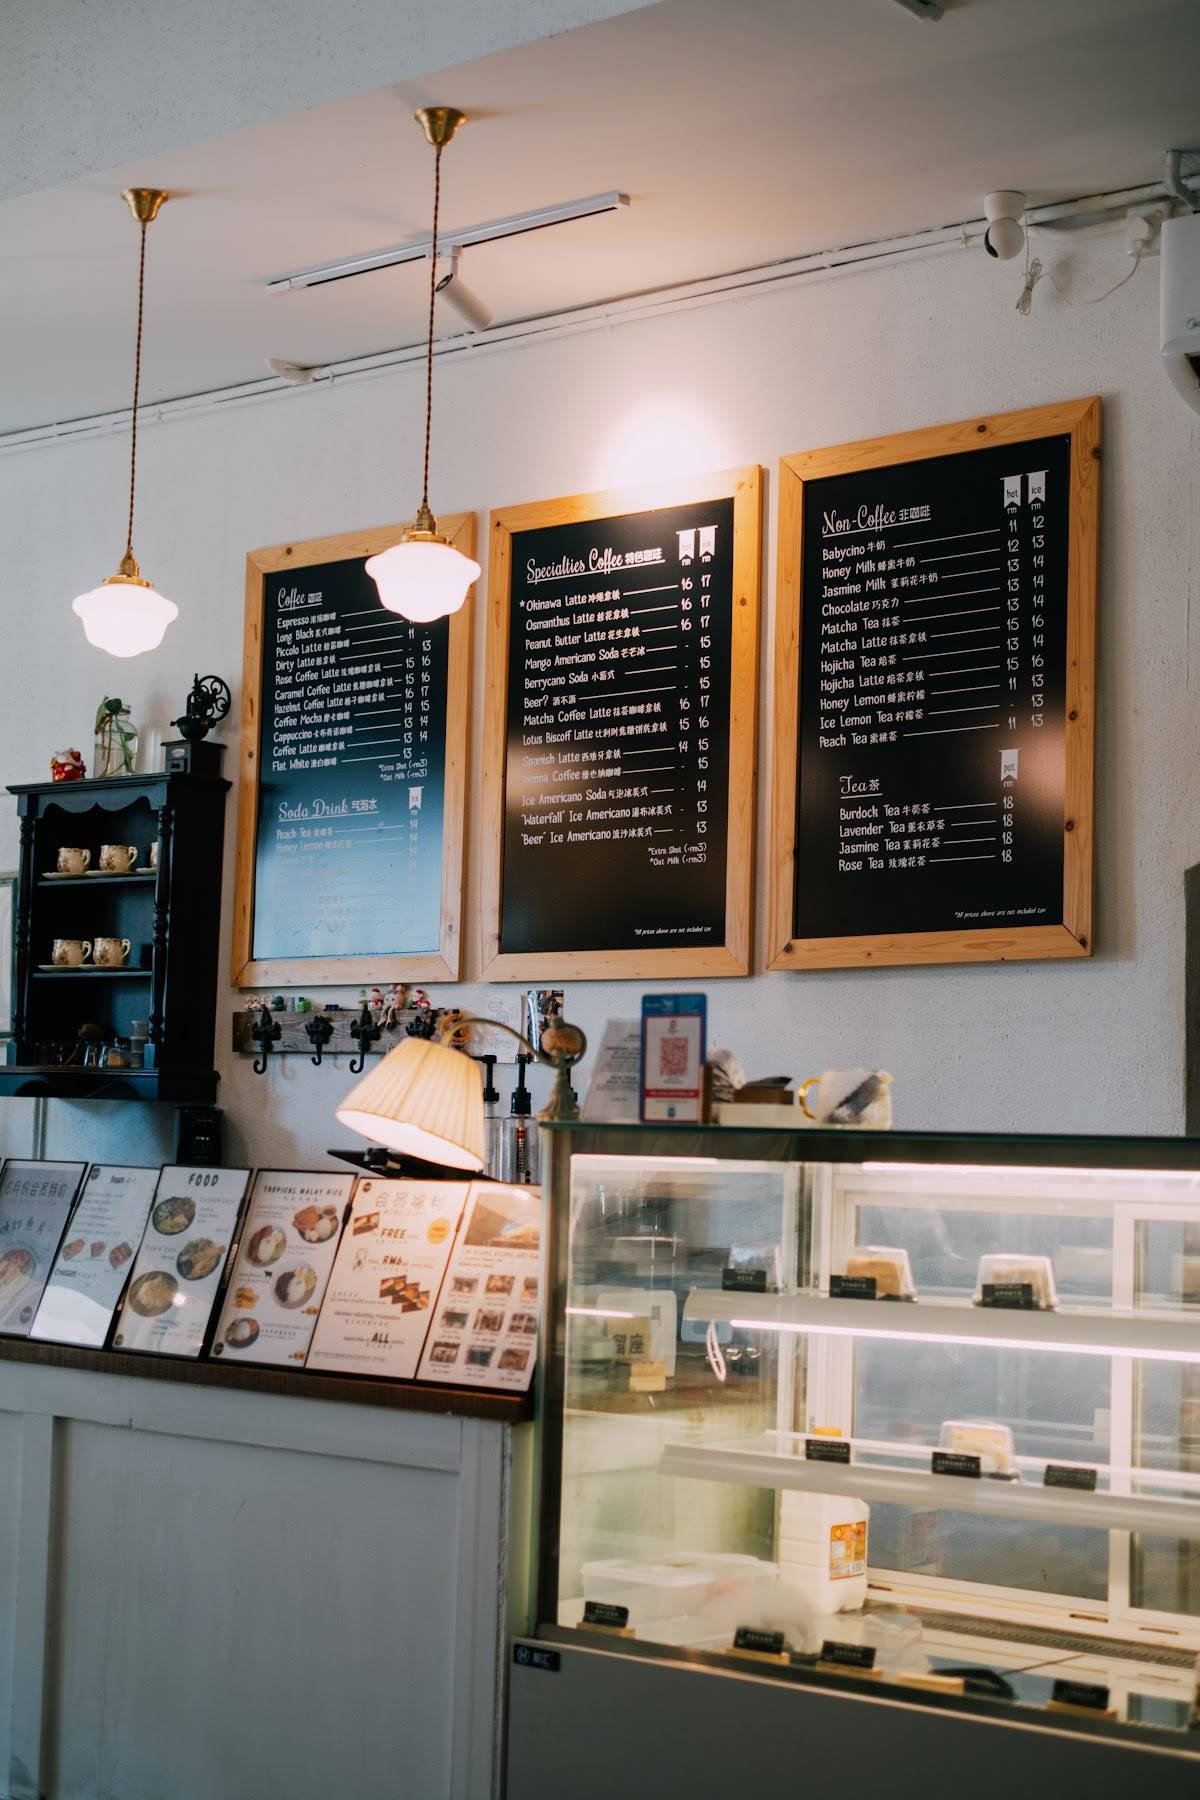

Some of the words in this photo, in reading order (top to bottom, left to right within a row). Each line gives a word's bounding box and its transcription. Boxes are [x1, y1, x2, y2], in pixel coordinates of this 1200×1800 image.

[1006, 488, 1019, 498] hot
[1031, 484, 1042, 495] ice
[1006, 506, 1017, 514] rm
[1030, 502, 1041, 511] rm
[822, 504, 897, 535] Non-Coffee
[822, 544, 865, 562] Babycino
[866, 540, 886, 552] 牛奶
[1009, 519, 1017, 532] 11
[1032, 515, 1044, 528] 12
[526, 555, 586, 585] Specialties
[588, 547, 624, 575] Coffee
[821, 582, 861, 598] Jasmine
[865, 577, 886, 592] Milk
[1007, 558, 1019, 572] 13
[1032, 554, 1044, 568] 14
[822, 566, 851, 580] Honey
[855, 559, 876, 574] Milk
[278, 587, 305, 612] Coffee
[525, 598, 562, 611] Okinawa
[564, 594, 587, 606] Latte
[821, 600, 870, 616] Chocolate
[276, 616, 309, 630] Espresso
[525, 615, 570, 631] Osmanthus
[572, 612, 595, 625] Latte
[680, 597, 692, 611] 16
[700, 594, 711, 608] 17
[821, 619, 857, 635] Matcha
[861, 617, 879, 630] Tea
[1007, 597, 1019, 611] 13
[1032, 594, 1044, 608] 14
[275, 644, 299, 657] Piccolo
[301, 642, 322, 654] Latte
[408, 627, 414, 639] 11
[276, 632, 293, 645] Long
[295, 627, 314, 640] Black
[525, 637, 552, 650] Peanut
[554, 634, 581, 646] Butter
[583, 630, 606, 643] Latte
[820, 638, 857, 654] Matcha
[861, 636, 887, 649] Latte
[275, 660, 295, 673] Dirty
[296, 657, 315, 668] Latte
[422, 639, 431, 651] 13
[524, 658, 552, 672] Mango
[554, 652, 596, 666] Americano
[598, 646, 619, 661] Soda
[699, 635, 711, 648] 15
[820, 657, 855, 675] Hojicha
[859, 655, 876, 668] Tea
[1006, 637, 1019, 651] 13
[1032, 633, 1044, 647] 14
[275, 674, 293, 685] Rose
[295, 670, 319, 683] Coffee
[321, 668, 340, 679] Latte
[405, 656, 415, 669] 15
[421, 654, 431, 666] 16
[274, 686, 304, 701] Caramel
[306, 683, 330, 697] Coffee
[332, 682, 352, 693] Latte
[405, 672, 415, 685] 15
[421, 671, 430, 683] 16
[524, 676, 566, 691] Berrycano
[568, 670, 589, 684] Soda
[820, 676, 854, 694] Hojicha
[858, 674, 885, 687] Latte
[523, 694, 549, 709] Beer?
[699, 676, 710, 689] 15
[820, 698, 849, 712] Honey
[853, 694, 885, 707] Lemon
[1008, 676, 1016, 690] 11
[1031, 673, 1044, 687] 13
[273, 715, 298, 728] Coffee
[299, 712, 322, 725] Mocha
[404, 702, 412, 713] 14
[420, 699, 430, 711] 15
[274, 701, 301, 714] Hazelnut
[303, 698, 325, 711] Coffee
[326, 697, 343, 708] Latte
[523, 712, 554, 726] Matcha
[557, 708, 586, 722] Coffee
[589, 707, 611, 719] Latte
[820, 716, 836, 729] Ice
[839, 715, 872, 727] Lemon
[876, 710, 893, 723] Tea
[273, 729, 312, 744] Cappuccino
[522, 734, 543, 746] Lotus
[545, 729, 572, 744] Biscoff
[573, 728, 593, 740] Latte
[679, 717, 690, 730] 15
[698, 715, 709, 728] 16
[819, 733, 846, 748] Peach
[850, 732, 867, 745] Tea
[1008, 716, 1016, 730] 11
[1030, 713, 1043, 727] 13
[272, 744, 297, 757] Coffee
[298, 743, 318, 754] Latte
[403, 731, 412, 744] 13
[419, 730, 428, 742] 14
[272, 760, 287, 772] Flat
[289, 758, 310, 770] White
[522, 753, 555, 769] Spanish
[558, 752, 580, 764] Latte
[551, 769, 580, 782] Coffee
[697, 757, 708, 769] 15
[839, 775, 867, 792] Tea
[521, 792, 536, 806] Ice
[538, 790, 582, 805] Americano
[585, 787, 607, 801] Soda
[278, 801, 308, 820] Soda
[312, 798, 349, 817] Drink
[568, 810, 583, 822] Ice
[585, 807, 631, 821] Americano
[696, 800, 707, 813] 13
[839, 804, 878, 820] Burdock
[883, 803, 900, 817] Tea
[839, 822, 884, 837] Lavender
[888, 820, 905, 833] Tea
[1002, 813, 1013, 827] 18
[550, 831, 564, 843] Ice
[567, 829, 611, 842] Americano
[838, 840, 879, 854] Jasmine
[883, 838, 901, 851] Tea
[838, 859, 863, 872] Rose
[867, 856, 884, 869] Tea
[1001, 848, 1012, 862] 18
[188, 1172, 219, 1187] FOOD
[381, 1228, 408, 1239] FREE
[371, 1332, 390, 1344] ALL
